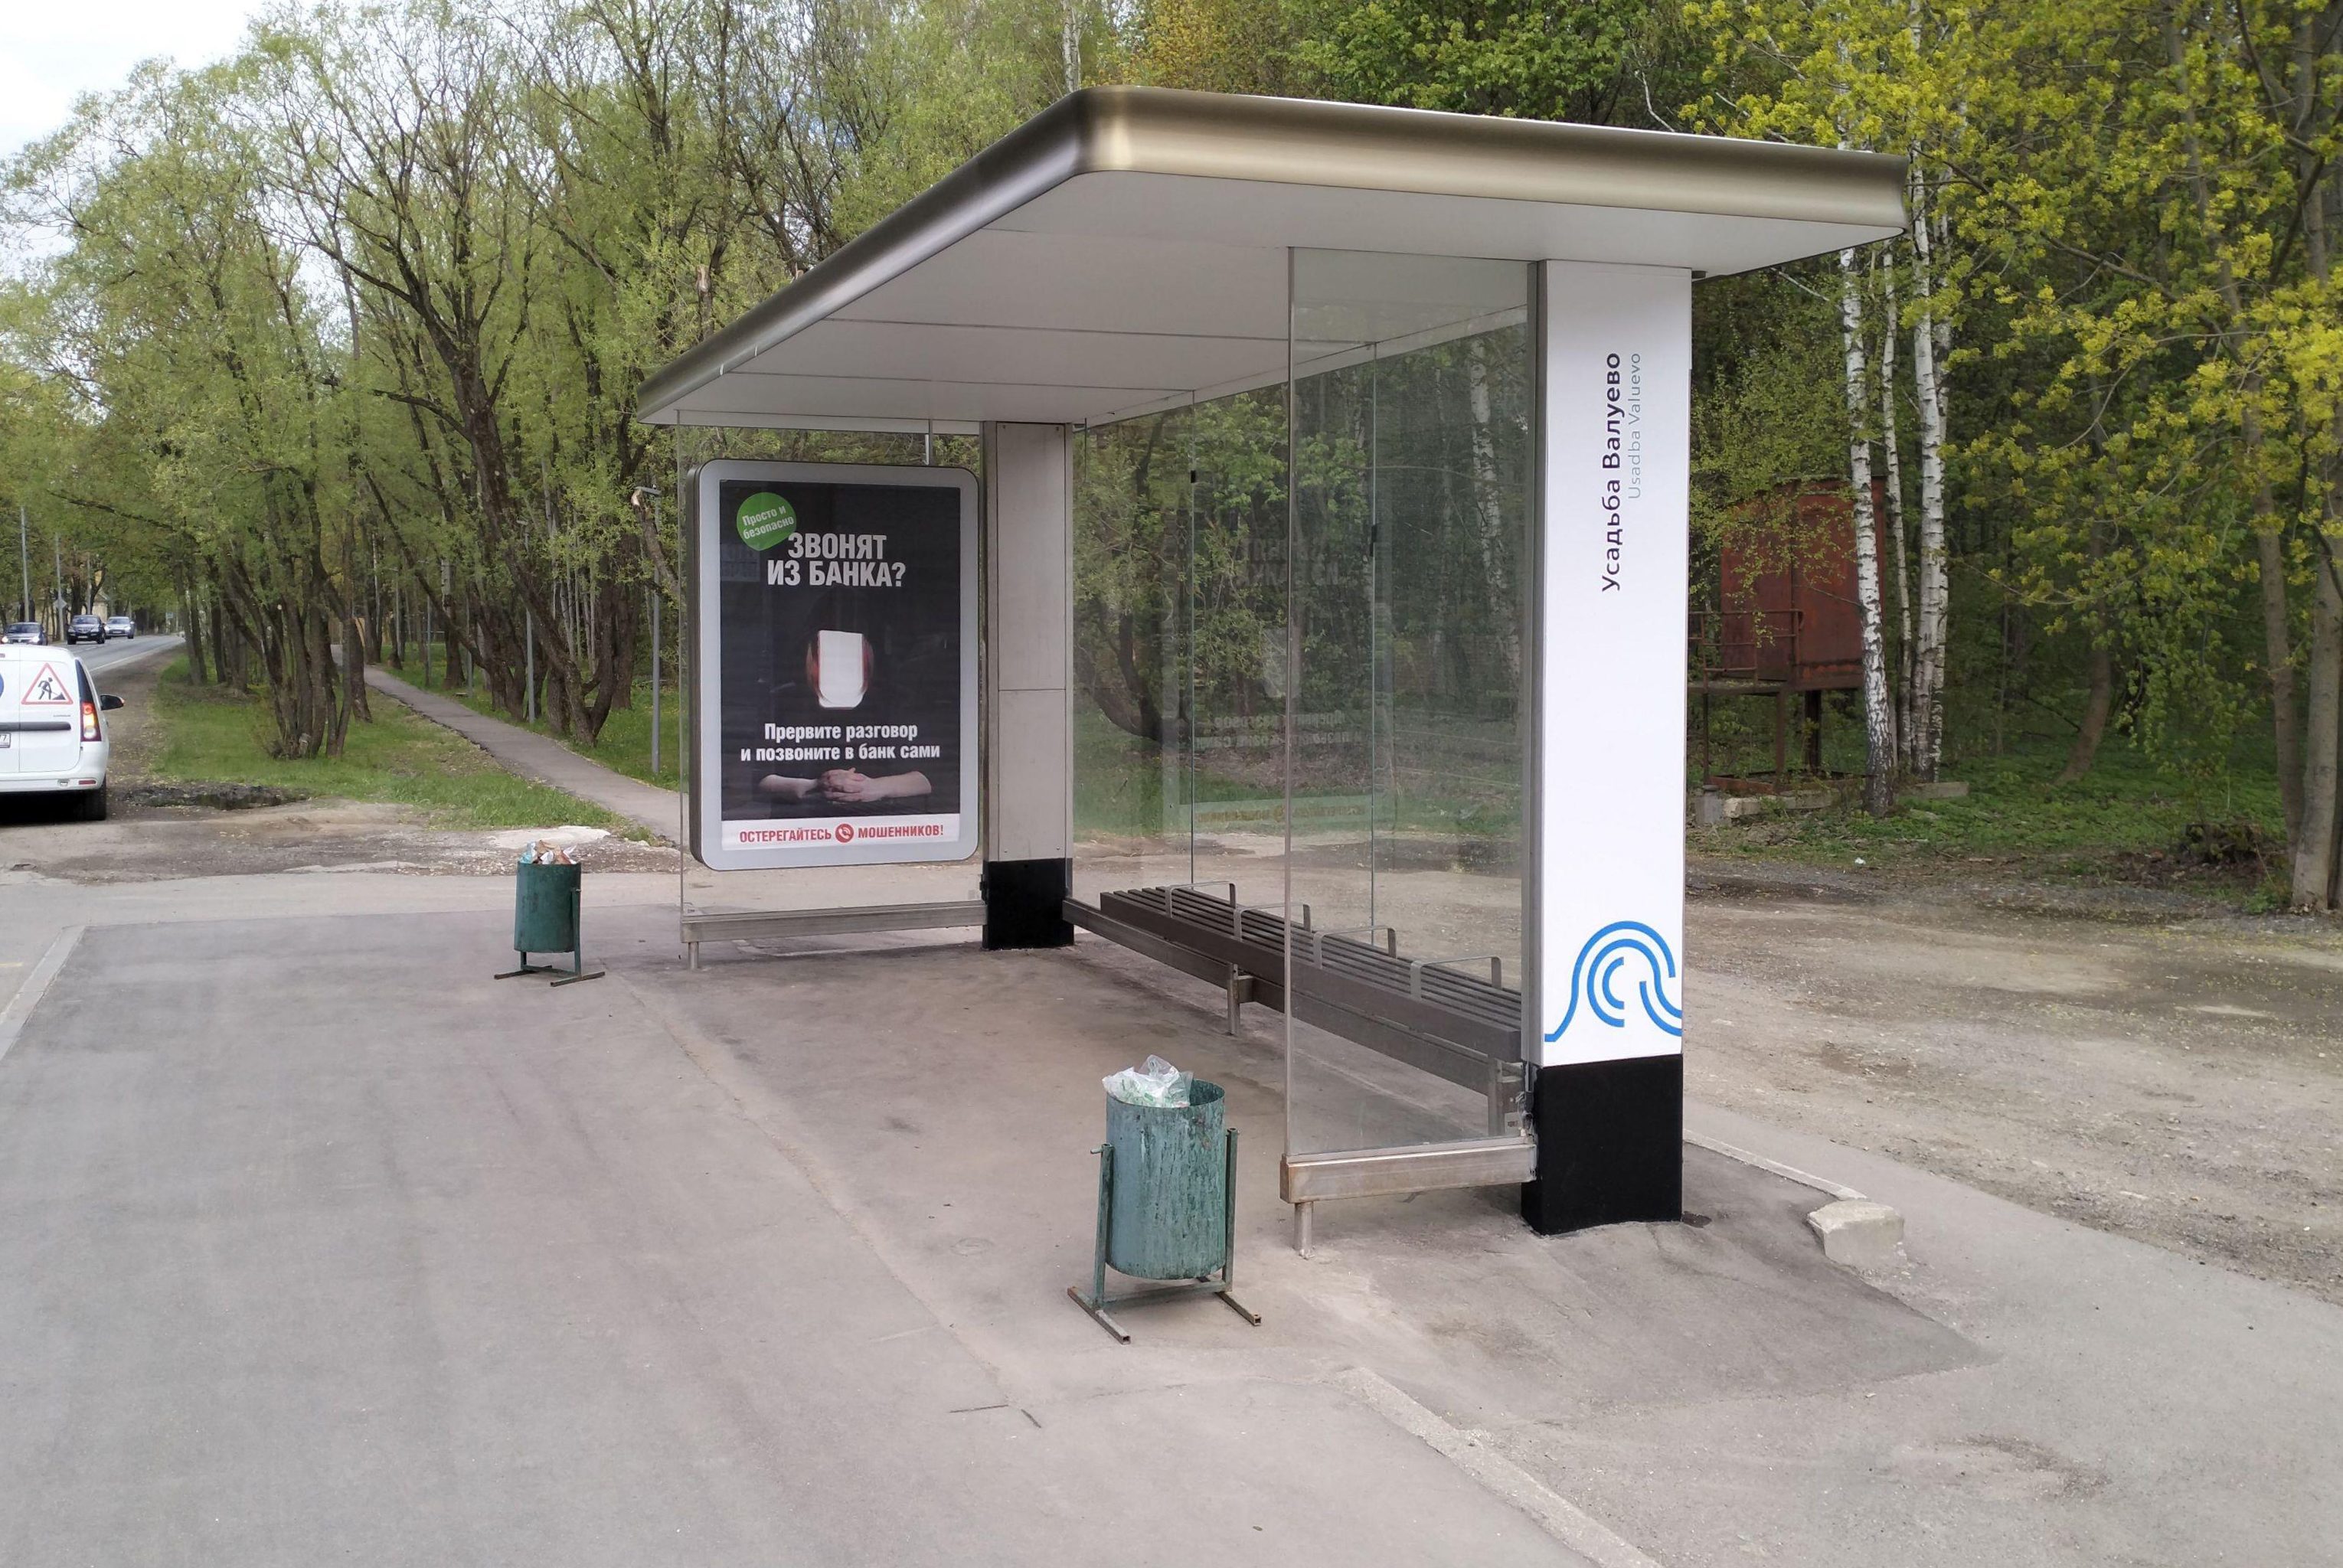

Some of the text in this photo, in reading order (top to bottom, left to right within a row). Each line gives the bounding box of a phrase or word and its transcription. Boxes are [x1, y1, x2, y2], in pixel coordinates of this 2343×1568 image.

[1628, 353, 1641, 499] Usadba Valuevo
[1601, 353, 1625, 592] Усадьба Валуево
[742, 505, 786, 527] Просто и
[743, 516, 795, 540] безопасно
[788, 533, 887, 560] ЗВОНЯТ
[767, 560, 906, 586] ИЗ БАНКА?
[764, 723, 918, 743] Прервите разговор
[740, 743, 940, 762] и позвоните в банк сами
[740, 825, 943, 843] ОСТЕРЕГАЙТЕСЬ МОШЕННИКОВ!
